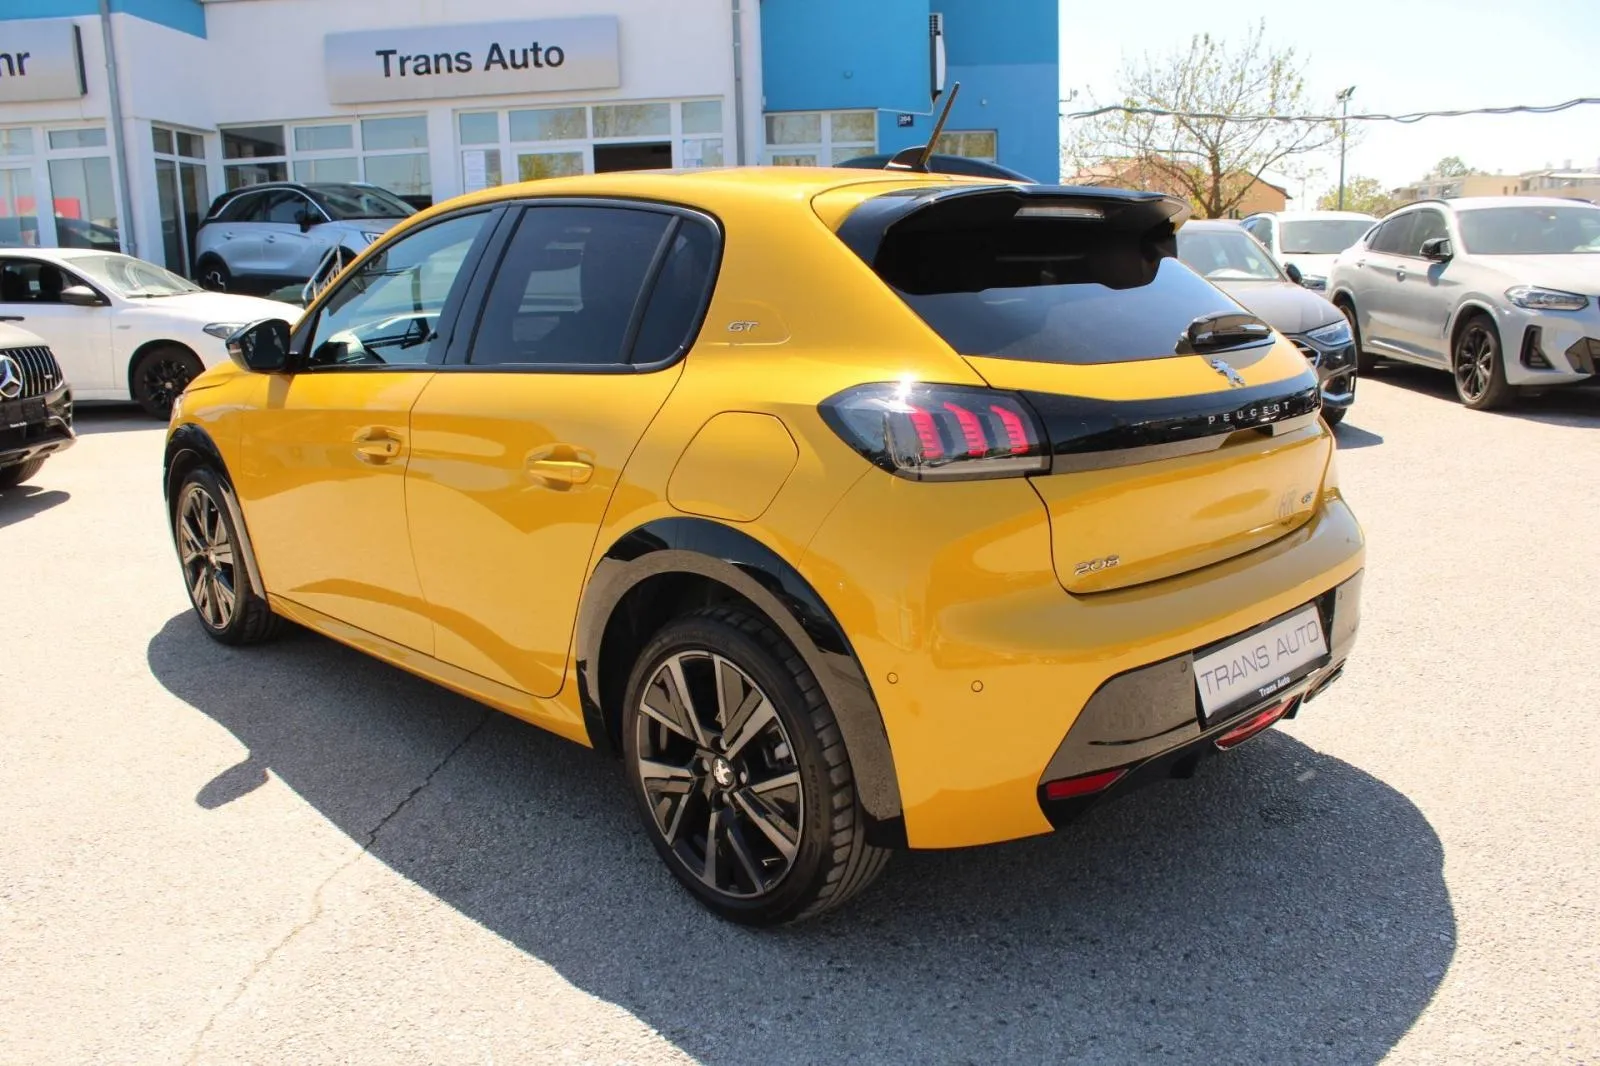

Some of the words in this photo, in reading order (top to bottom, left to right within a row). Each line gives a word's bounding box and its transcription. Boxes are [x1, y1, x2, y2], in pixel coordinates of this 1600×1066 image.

[375, 49, 473, 78] Trans
[483, 41, 565, 72] Auto
[727, 320, 760, 333] GT
[1207, 401, 1291, 425] PEUGEOT
[1074, 554, 1120, 575] 208
[1200, 645, 1270, 696] TRANS
[1276, 620, 1320, 661] AUTO
[1258, 683, 1277, 697] Trans
